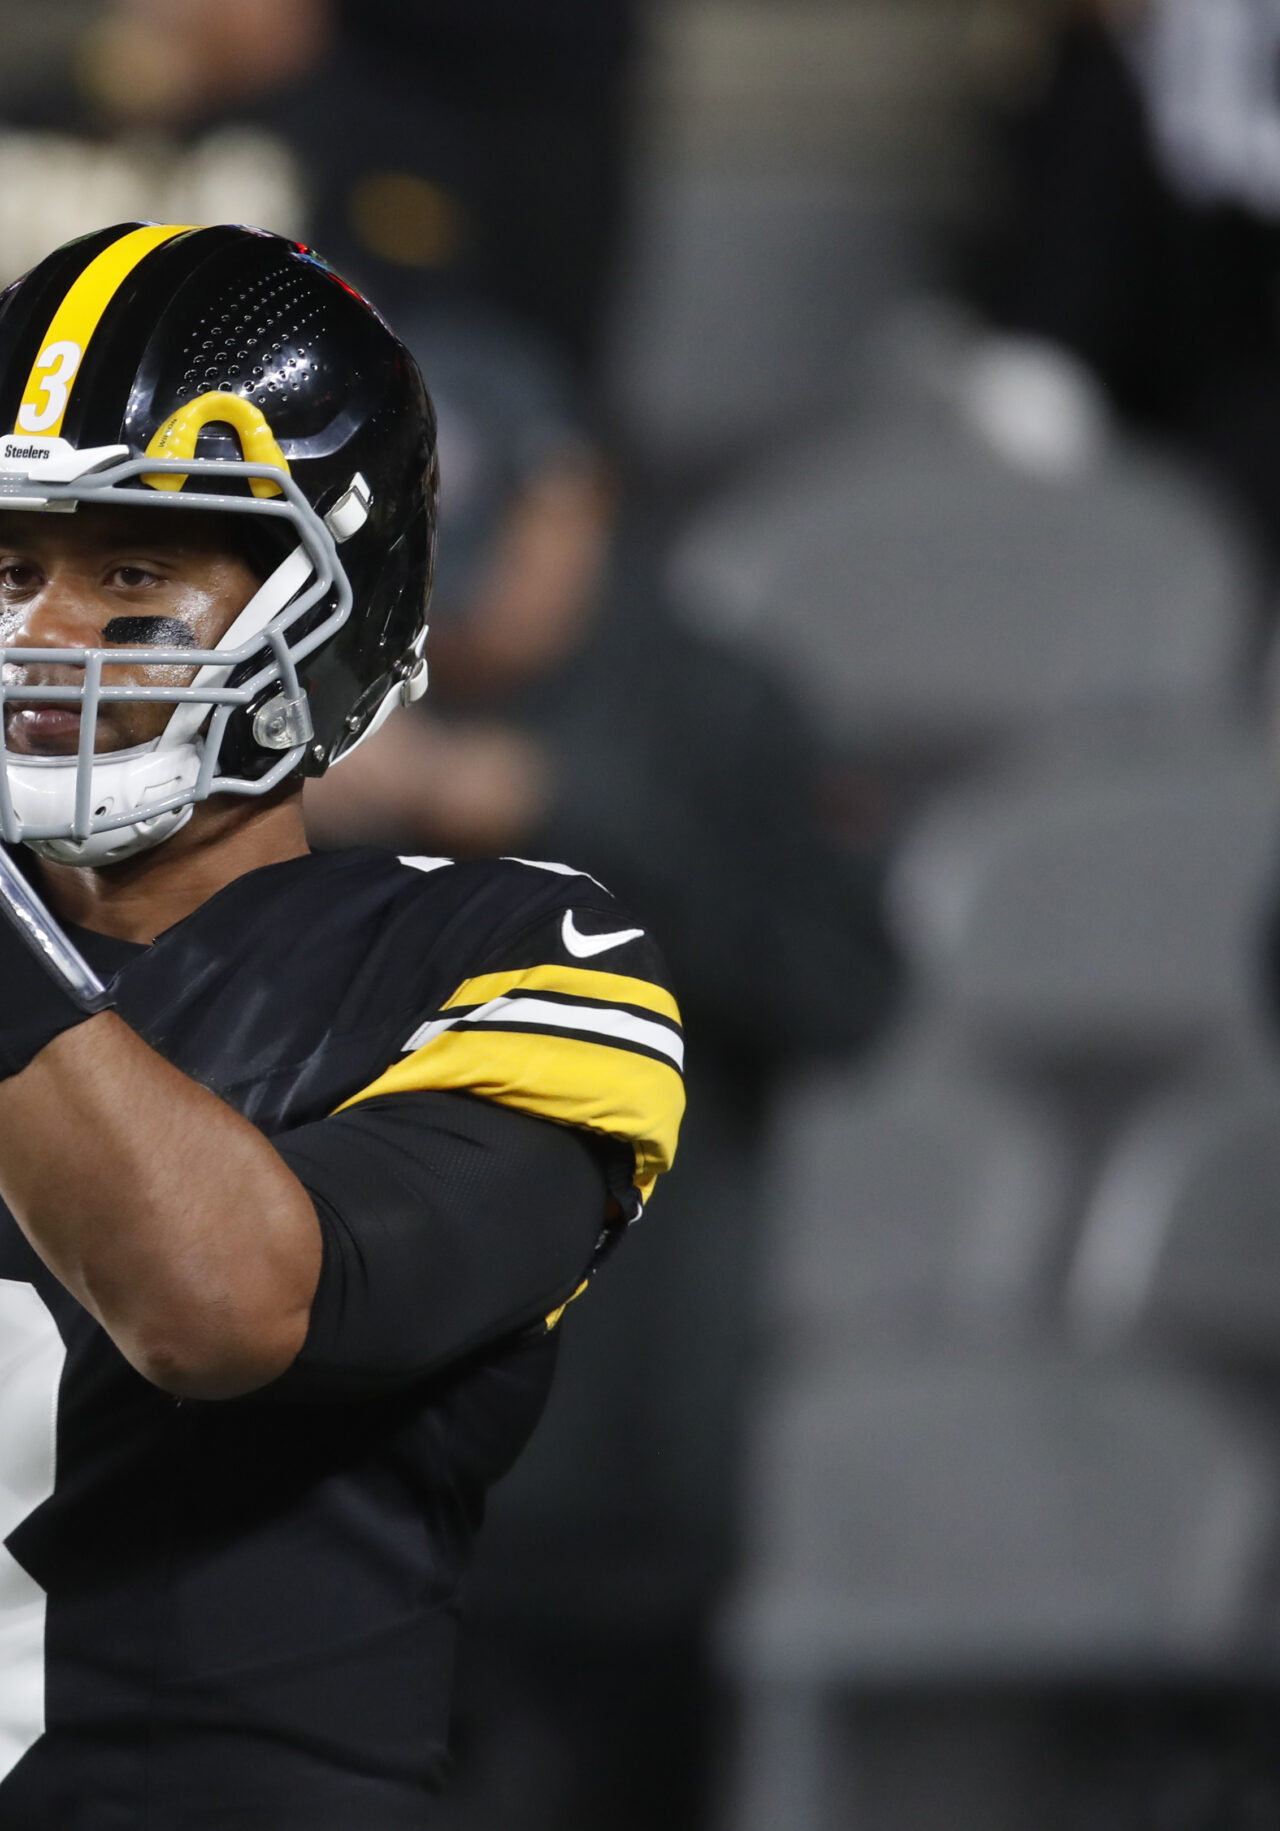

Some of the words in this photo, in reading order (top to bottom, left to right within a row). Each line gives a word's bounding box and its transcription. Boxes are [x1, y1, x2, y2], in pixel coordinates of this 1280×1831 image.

[18, 340, 82, 432] 3
[158, 418, 178, 448] WILON
[4, 444, 50, 459] Steelers
